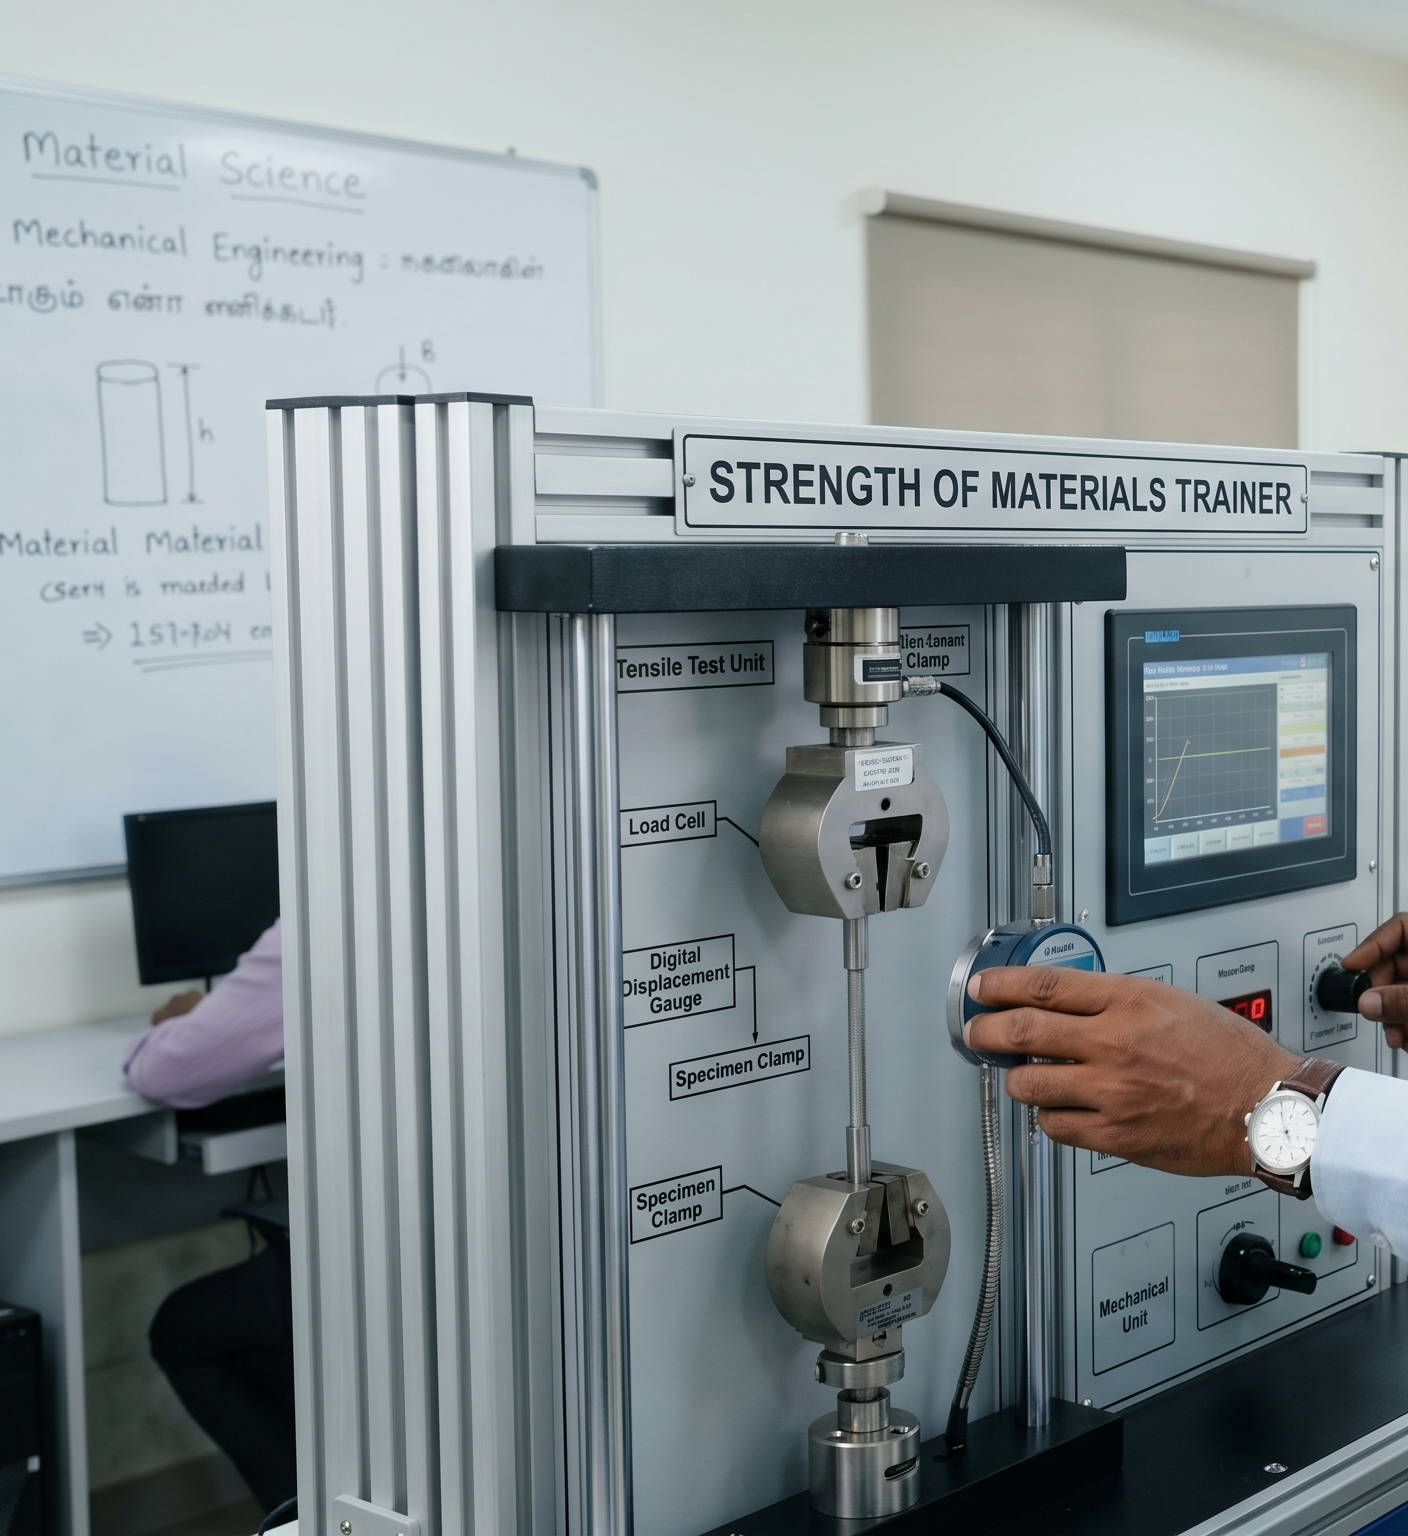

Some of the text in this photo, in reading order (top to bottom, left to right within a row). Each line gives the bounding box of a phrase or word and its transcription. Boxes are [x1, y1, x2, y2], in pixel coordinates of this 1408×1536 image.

[22, 130, 368, 200] Material Science
[12, 218, 189, 257] Mechanical
[212, 230, 365, 286] Engineering
[708, 459, 1293, 515] STRENGTH OF MATERIALS TRAINER
[145, 522, 263, 556] Material
[616, 652, 766, 679] Tensile Test Unit
[906, 652, 950, 671] Clamp
[628, 810, 706, 836] Load Cell
[650, 945, 701, 972] Digital
[623, 963, 730, 998] Displacement
[649, 992, 702, 1014] Gauge
[675, 1047, 805, 1090] Specimen Clamp
[635, 1178, 716, 1213] Specimen
[651, 1203, 703, 1229] Clamp
[1099, 1276, 1169, 1319] Mechanical
[1121, 1310, 1149, 1334] Unit
